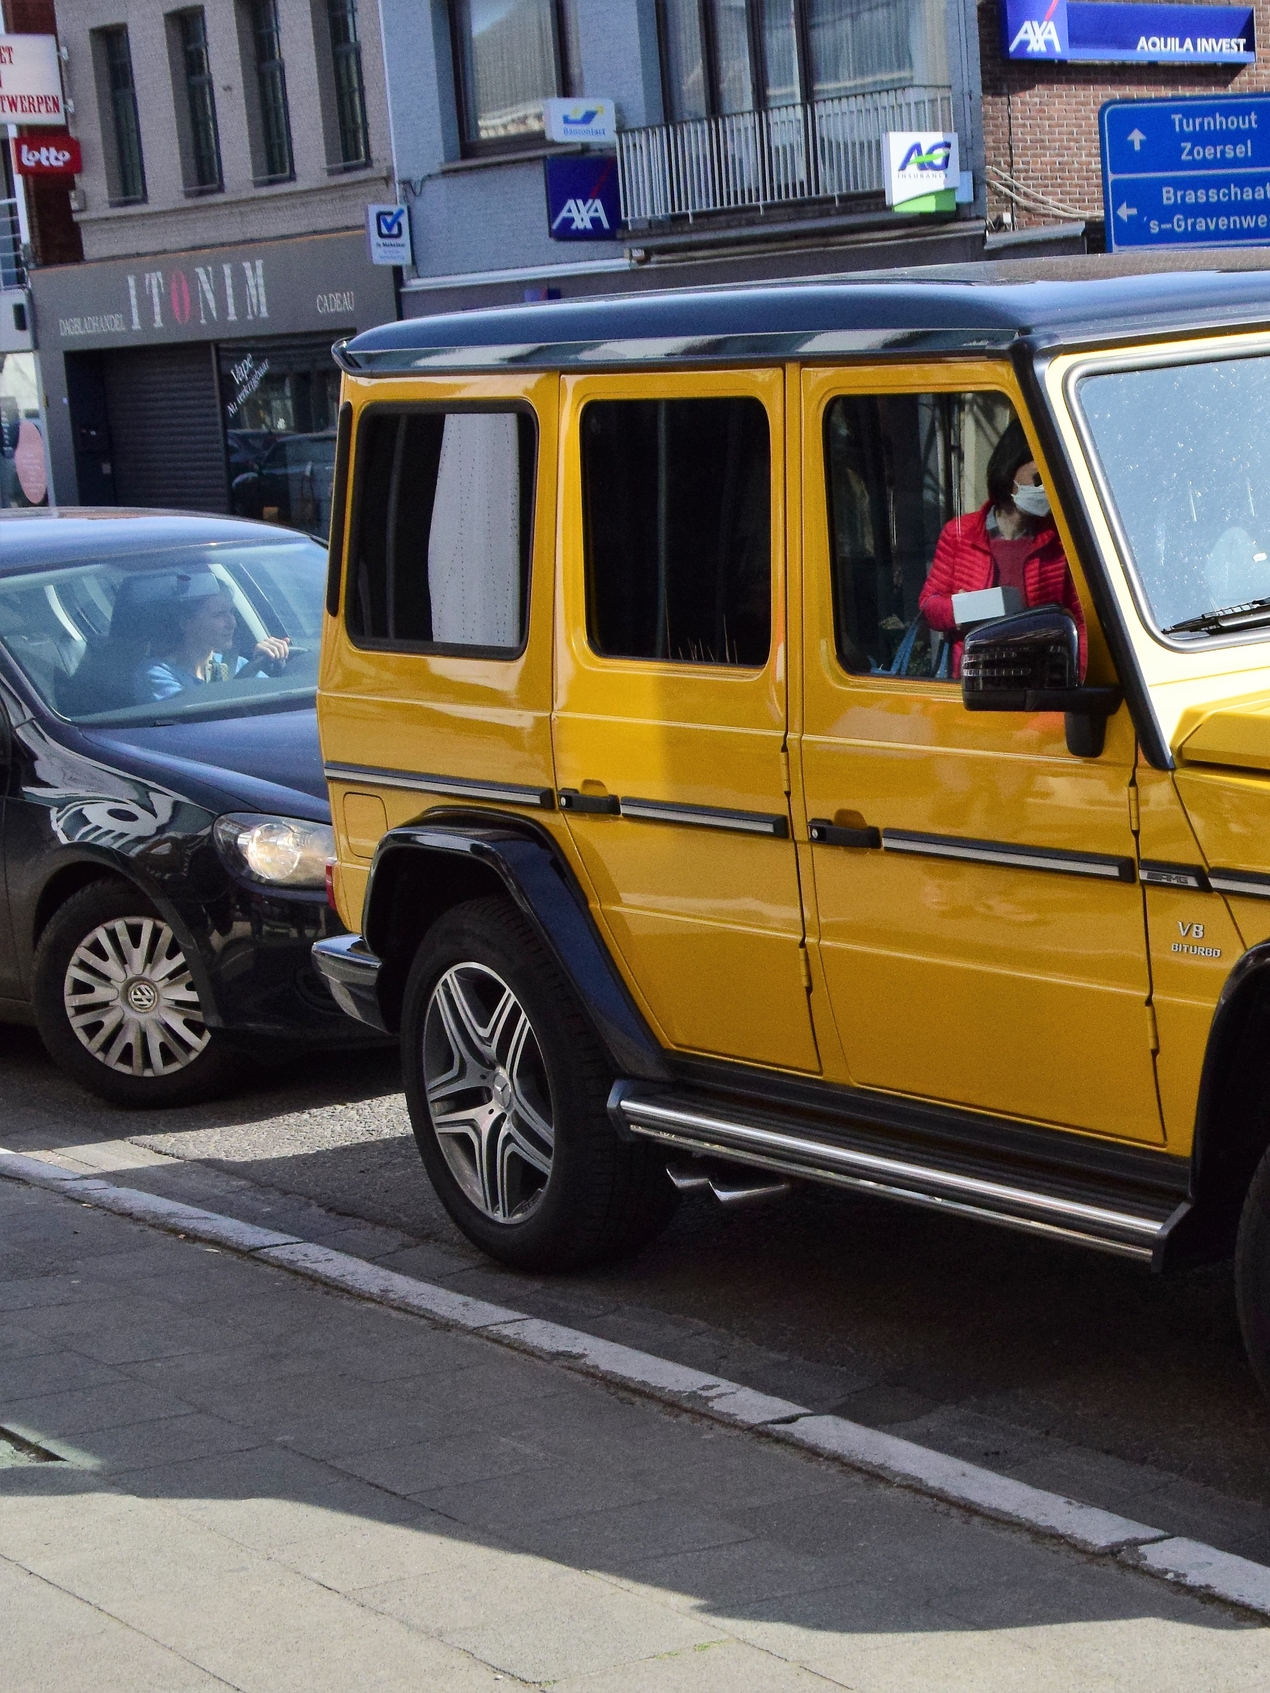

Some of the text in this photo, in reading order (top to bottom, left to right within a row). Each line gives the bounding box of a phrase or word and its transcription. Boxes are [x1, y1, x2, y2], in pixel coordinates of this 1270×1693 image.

[1009, 21, 1062, 53] AXA
[1137, 37, 1246, 54] AQUILA INVEST
[1171, 111, 1258, 132] Turnhout
[21, 144, 71, 167] lotto
[898, 141, 952, 172] AG
[1181, 139, 1252, 160] Zoersel
[552, 199, 610, 230] AXA
[127, 259, 270, 330] ITONIM
[316, 290, 355, 314] CADEAU
[59, 313, 126, 336] DAGBLADHANDEL
[1178, 921, 1205, 939] V8
[1171, 943, 1221, 958] BITURBO
